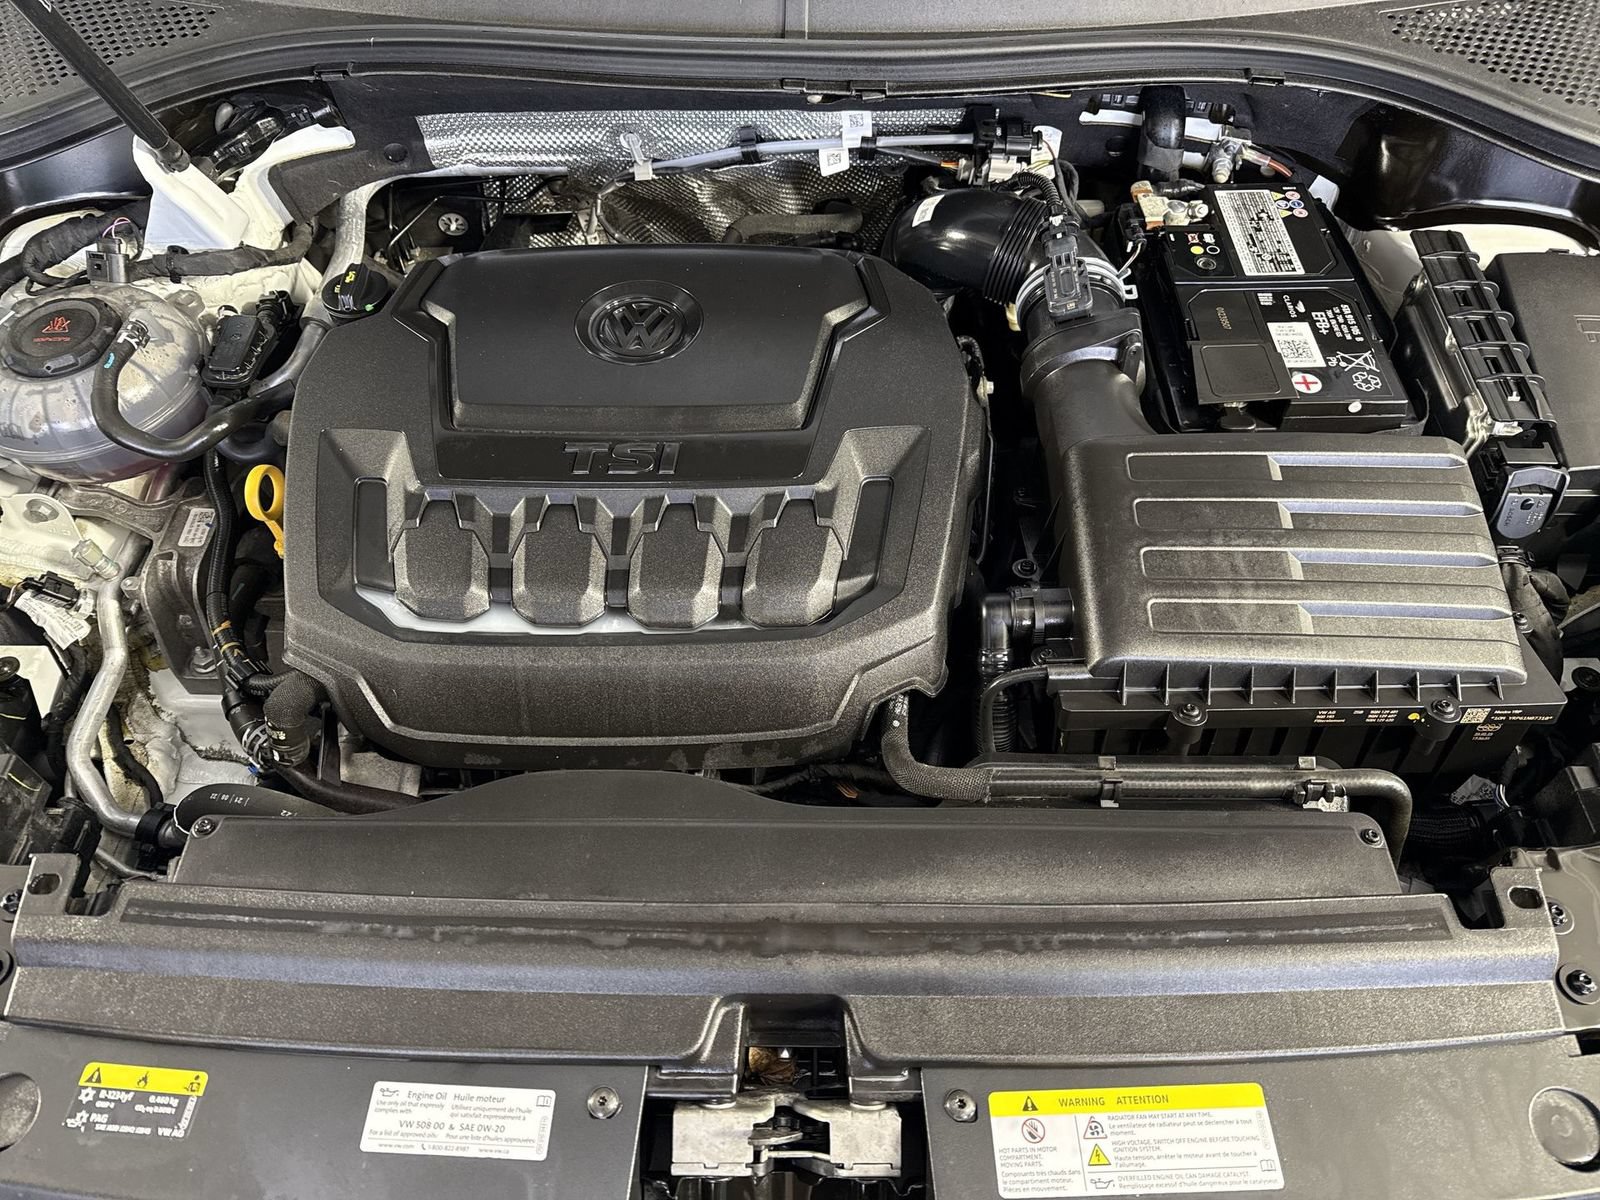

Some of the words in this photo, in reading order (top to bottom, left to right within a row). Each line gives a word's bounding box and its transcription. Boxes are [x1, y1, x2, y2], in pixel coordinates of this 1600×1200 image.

[1283, 295, 1297, 318] CLARIOS
[1311, 312, 1330, 335] EFB+
[1326, 356, 1338, 366] Pb
[565, 441, 683, 475] TSI
[408, 1090, 434, 1101] Engine
[436, 1092, 448, 1100] Oil
[454, 1093, 475, 1102] Huile
[1058, 1097, 1106, 1108] WARNING
[1116, 1094, 1170, 1106] ATTENTION
[90, 1112, 109, 1124] PAG
[399, 1120, 414, 1128] VW
[416, 1120, 432, 1130] 508
[432, 1122, 446, 1130] 00
[460, 1123, 476, 1132] SAE
[476, 1124, 506, 1133] 0W-20
